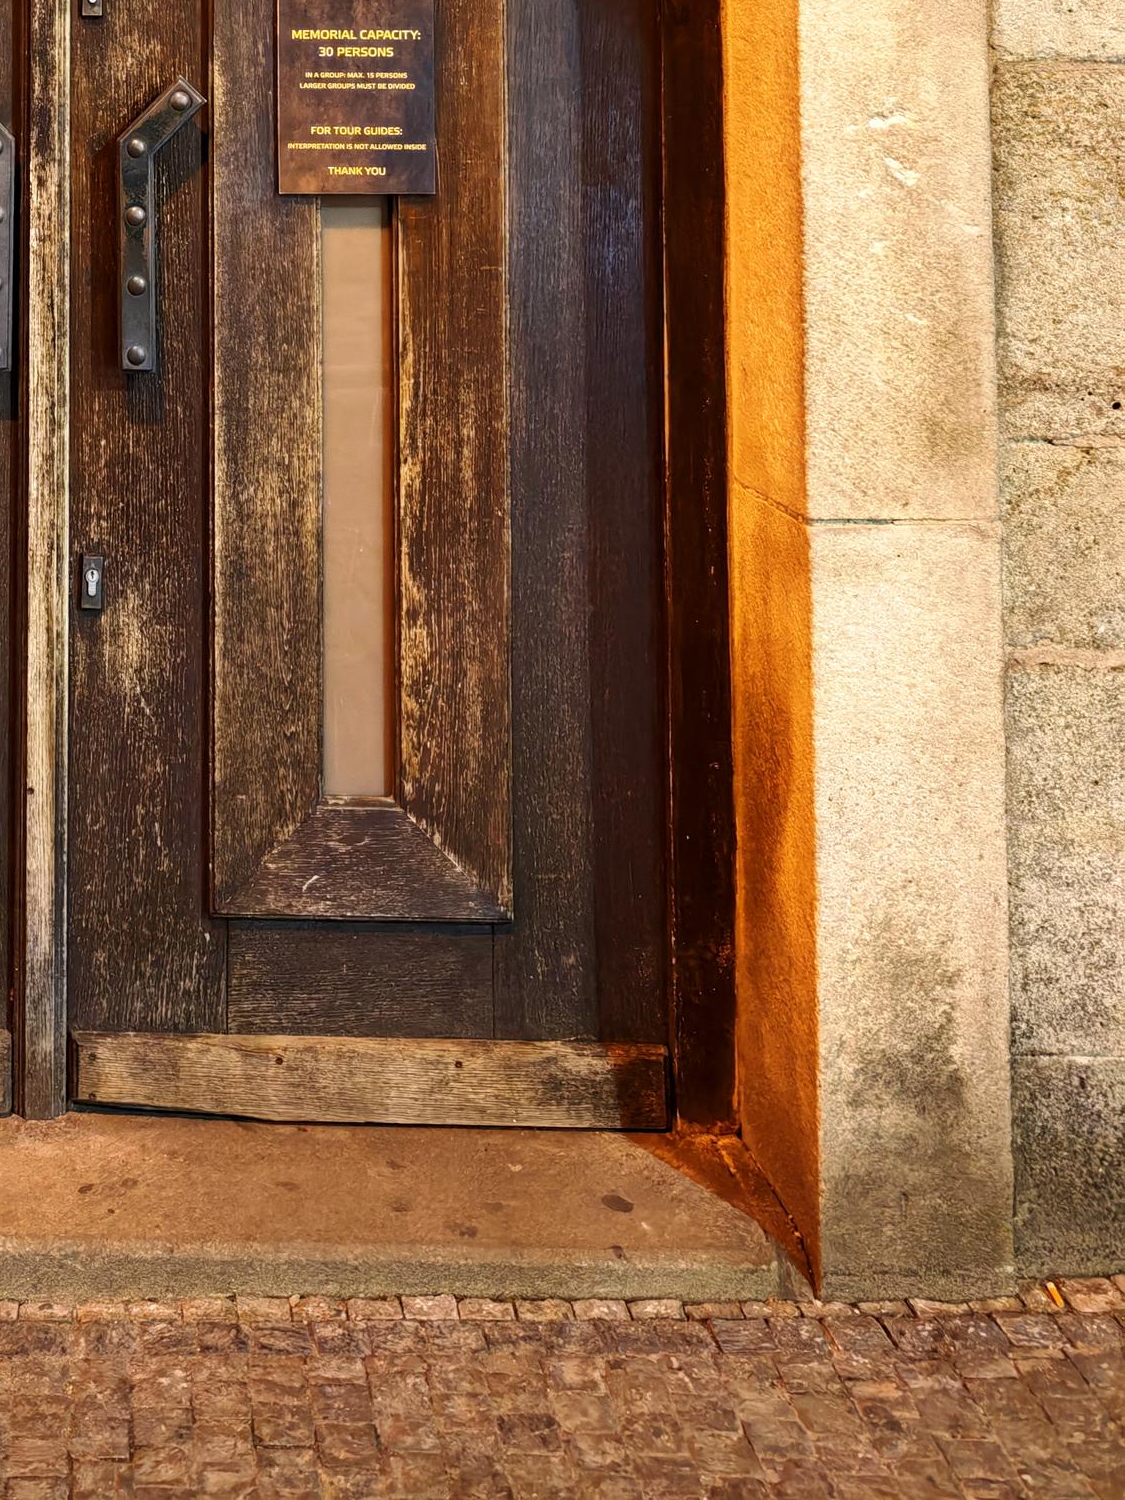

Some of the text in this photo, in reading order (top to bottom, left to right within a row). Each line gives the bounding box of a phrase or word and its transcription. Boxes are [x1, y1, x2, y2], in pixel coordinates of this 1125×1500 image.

[291, 29, 421, 40] MEMORIAL CAPACITY:
[318, 47, 394, 57] 30 PERSONS
[327, 82, 356, 90] GROUPS
[310, 126, 403, 136] FOR TOUR GUIDES:
[287, 142, 345, 150] INTERPRETATION
[346, 142, 353, 150] IS
[354, 142, 369, 150] NOT
[404, 143, 427, 151] INSIDE
[328, 166, 387, 176] THANK YOU
